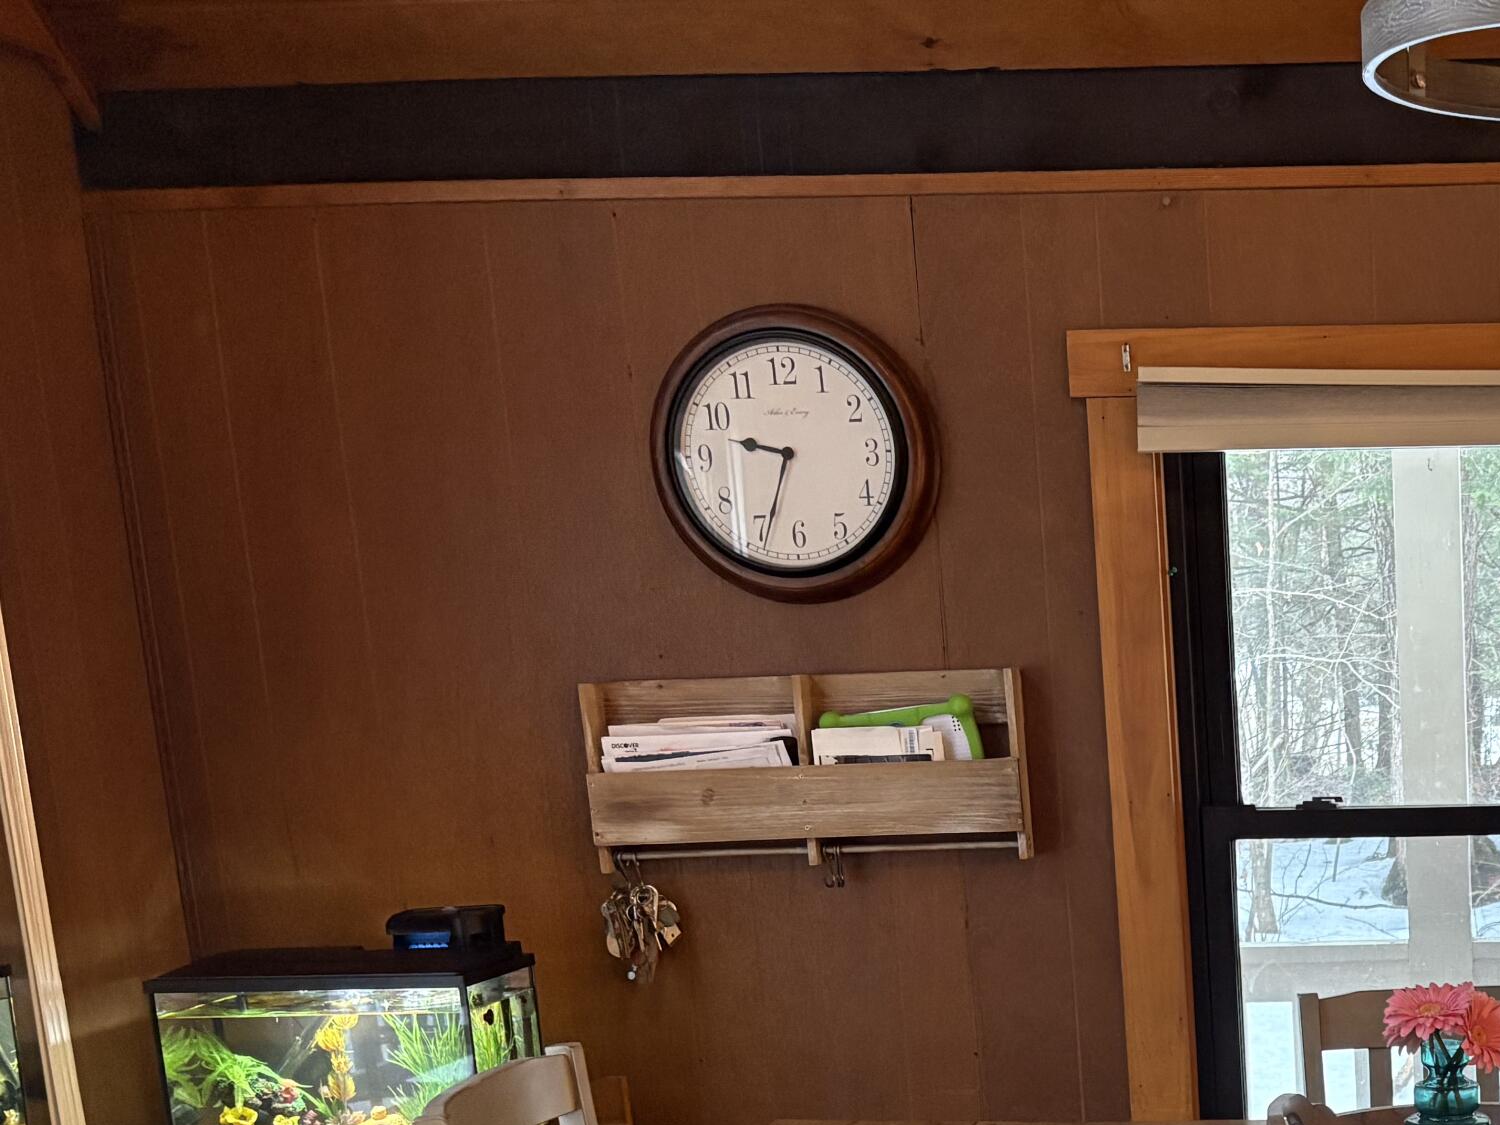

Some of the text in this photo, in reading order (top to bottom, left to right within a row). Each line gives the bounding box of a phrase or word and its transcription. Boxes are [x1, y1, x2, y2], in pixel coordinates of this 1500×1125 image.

[729, 371, 755, 399] 11
[767, 357, 796, 385] 12
[814, 365, 828, 393] 1
[703, 402, 730, 430] 10
[847, 394, 863, 422] 2
[698, 444, 712, 472] 9
[865, 439, 879, 466] 3
[718, 487, 732, 514] 8
[859, 479, 875, 507] 4
[754, 515, 766, 543] 7
[792, 521, 806, 548] 6
[834, 513, 848, 540] 5
